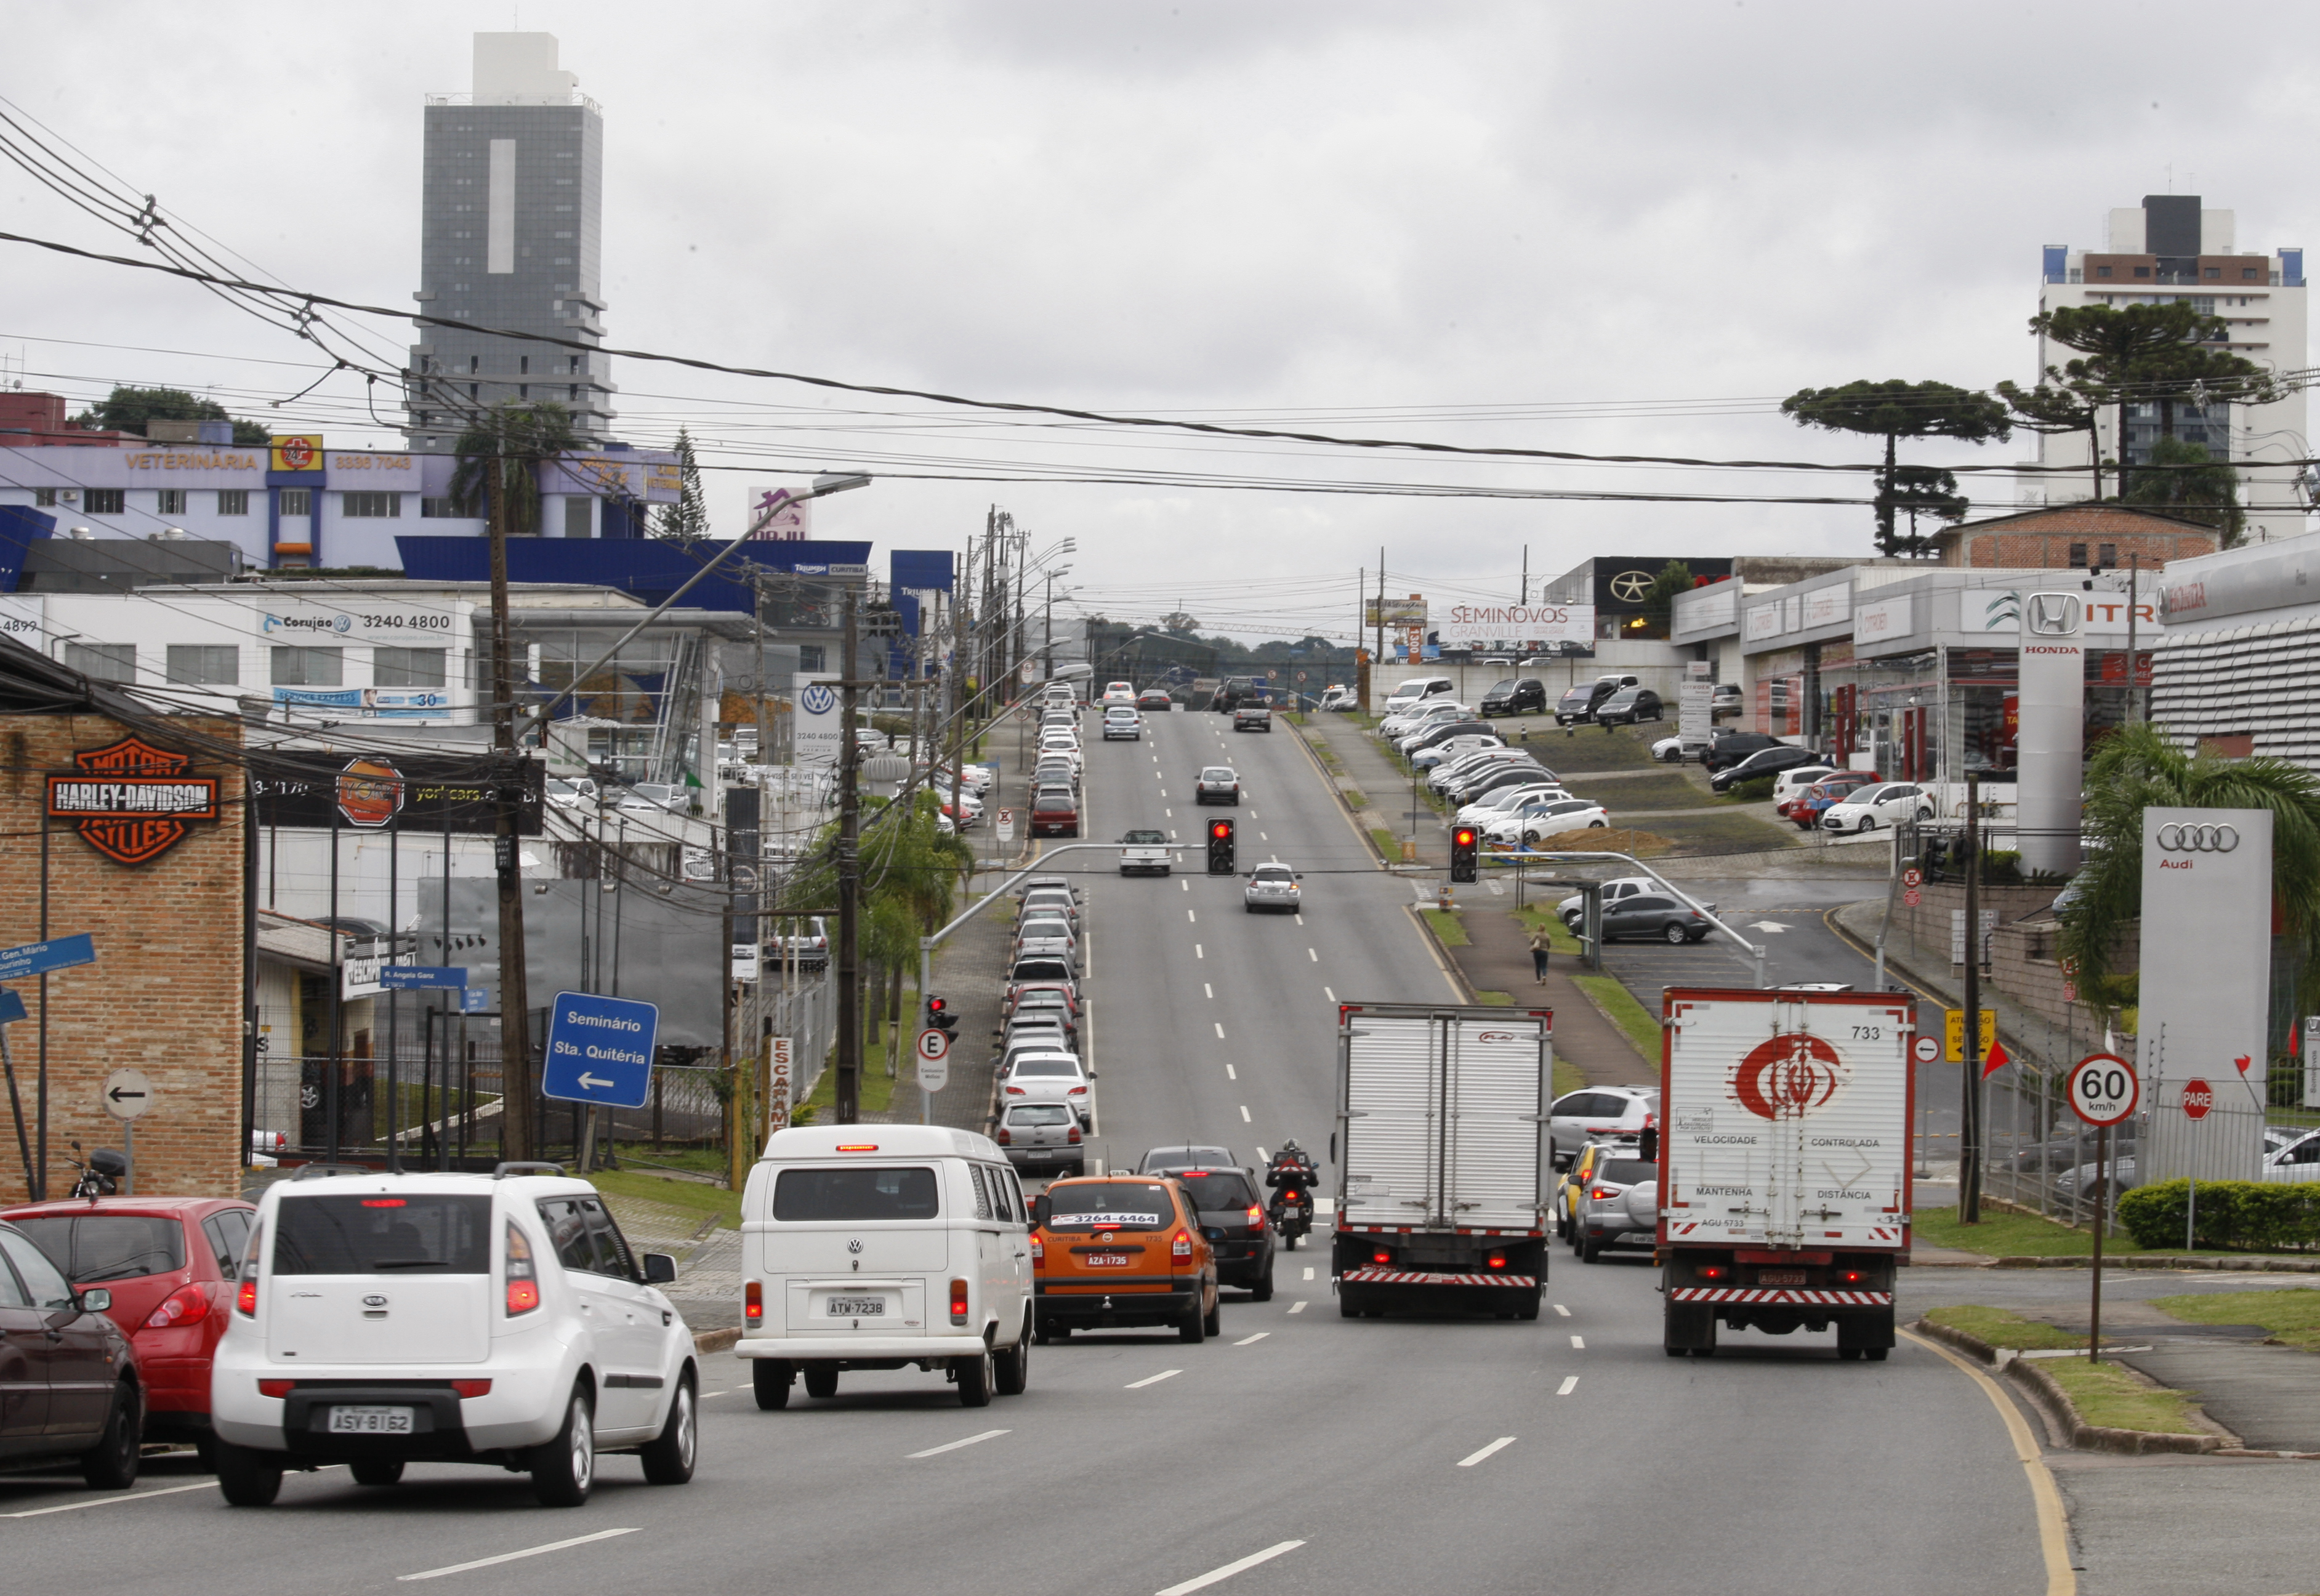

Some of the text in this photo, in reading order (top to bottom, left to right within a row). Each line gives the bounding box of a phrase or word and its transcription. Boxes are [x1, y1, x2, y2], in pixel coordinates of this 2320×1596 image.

[284, 448, 299, 461] 24
[335, 456, 412, 470] 3336 7043
[794, 564, 826, 574] TRIUMPH
[831, 566, 864, 574] CURITIBA
[1451, 607, 1568, 623] SEMINOVOS
[283, 616, 332, 632] Corujão
[363, 615, 403, 628] 3240
[408, 616, 449, 628] 4800
[1449, 624, 1523, 638] GRANVILLE
[1409, 629, 1420, 653] 1300
[2024, 647, 2080, 655] HONDA
[316, 691, 355, 702] EXPRESS
[417, 693, 437, 706] 30
[93, 745, 172, 775] MOTOR
[56, 783, 208, 812] HARLEY-DAVIDSON
[91, 820, 171, 855] CYCLES
[2159, 859, 2193, 869] Audi
[22, 945, 48, 956] Mário
[392, 971, 416, 980] Angela
[417, 971, 435, 979] Ganz
[567, 1011, 641, 1032] Seminário
[1851, 1026, 1880, 1040] 733
[927, 1036, 938, 1054] E
[554, 1041, 646, 1065] Sta. Quitéria
[2309, 1050, 2318, 1094] Seminovos
[2080, 1069, 2125, 1100] 60
[2088, 1101, 2116, 1111] km/h
[2183, 1092, 2212, 1107] PARE
[1694, 1135, 1880, 1148] VELOCIDADE CONTROLADA
[1696, 1187, 1872, 1199] MANTENHA DISTÂNCIA
[1074, 1214, 1156, 1223] 3264-6464
